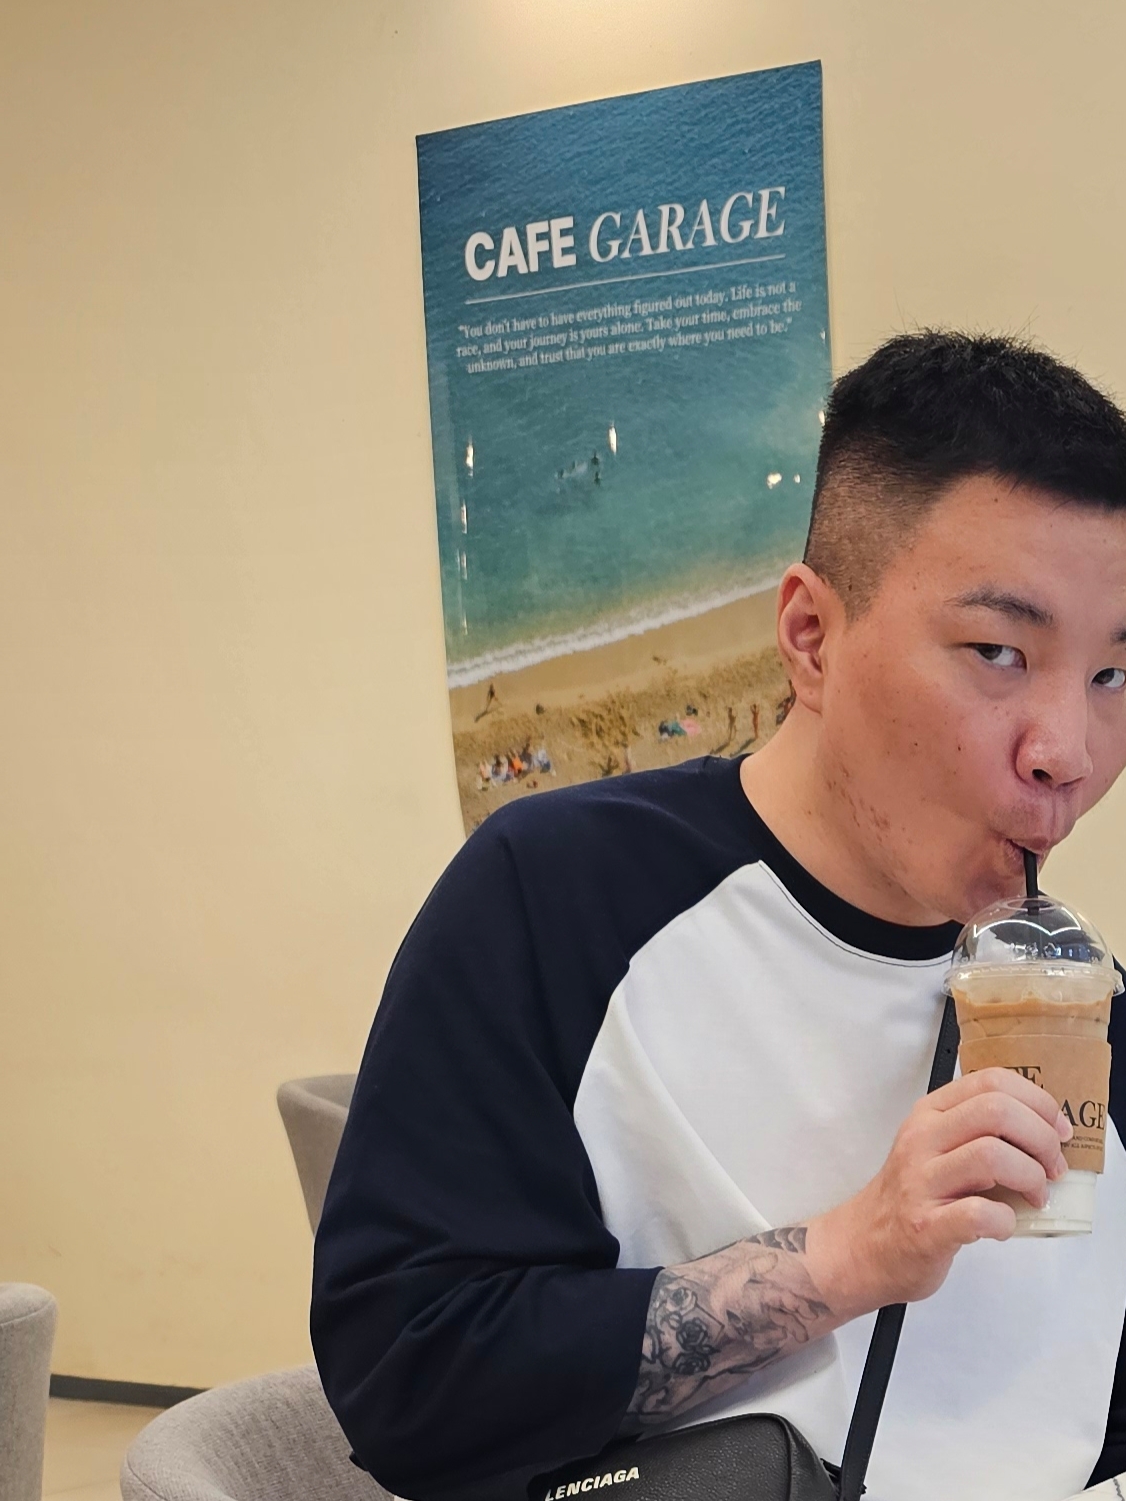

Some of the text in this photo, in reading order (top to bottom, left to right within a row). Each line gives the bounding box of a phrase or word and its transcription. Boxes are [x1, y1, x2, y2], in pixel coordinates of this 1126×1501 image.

[464, 186, 786, 281] CAFE GARAGE
[456, 297, 802, 357] race, and your journey is yours alone. Take your time, embrace the
[485, 318, 510, 335] don't
[513, 318, 536, 332] have
[538, 316, 549, 328] to
[550, 312, 575, 326] have
[576, 302, 632, 323] everything
[633, 295, 672, 316] figured
[674, 295, 692, 309] out
[694, 289, 728, 307] today.
[730, 283, 752, 300] Life
[755, 283, 766, 298] is
[767, 281, 786, 296] not
[789, 281, 796, 293] a
[467, 358, 517, 374] unknown,
[518, 351, 538, 367] and
[540, 349, 564, 364] trust
[565, 345, 585, 361] that
[587, 344, 606, 361] you
[607, 342, 626, 355] are
[628, 334, 666, 352] exactly
[667, 331, 702, 347] where
[703, 330, 725, 347] you
[726, 320, 753, 340] need
[755, 322, 768, 336] to
